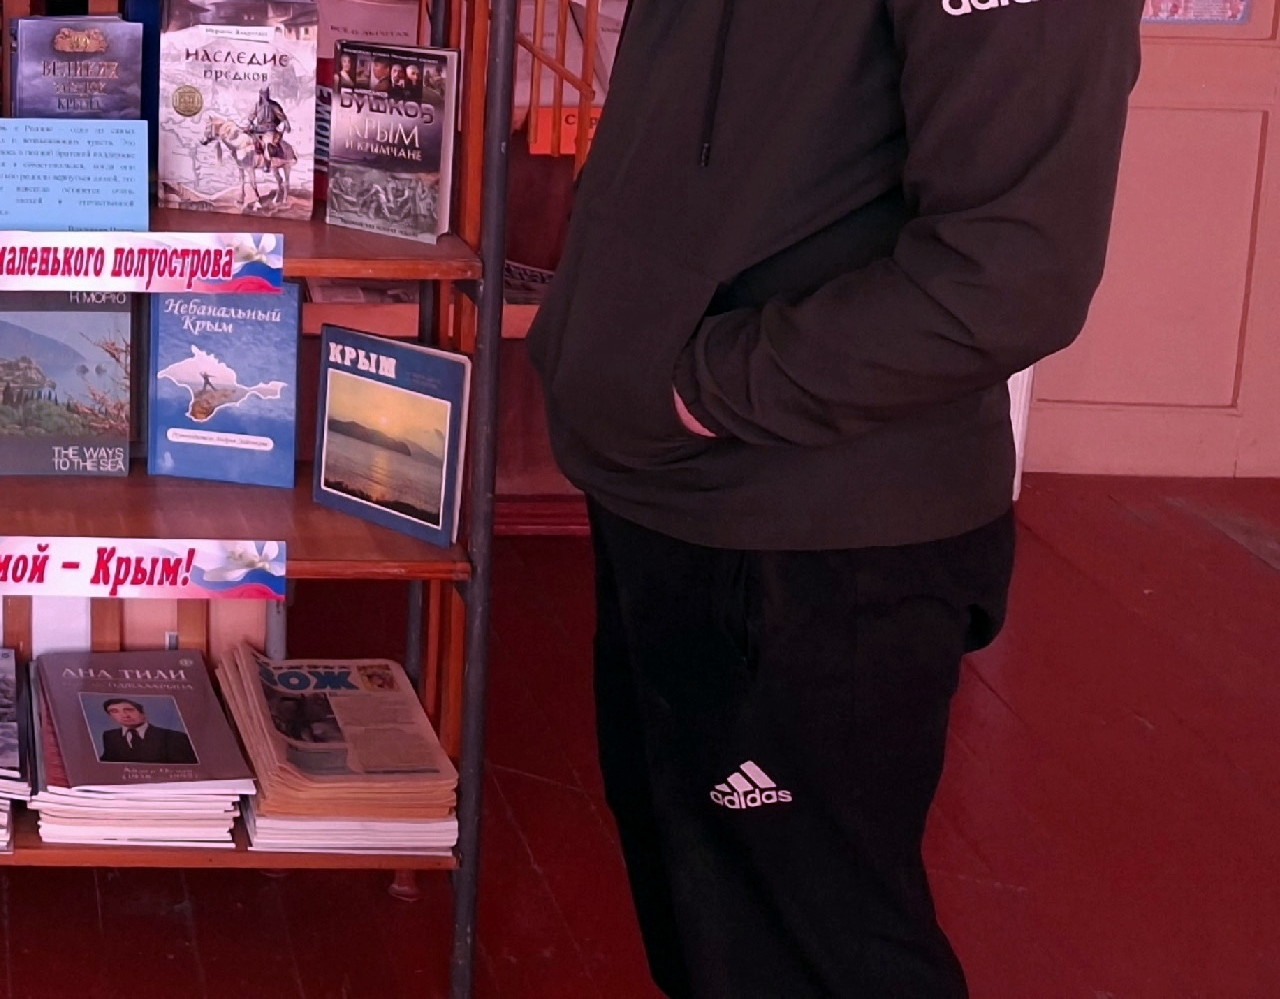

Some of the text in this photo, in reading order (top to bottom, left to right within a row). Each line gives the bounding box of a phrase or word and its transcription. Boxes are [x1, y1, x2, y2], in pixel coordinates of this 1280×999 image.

[185, 48, 290, 69] НАСЛЕДИЕ
[203, 69, 269, 83] ПРЕДКОВ
[340, 87, 435, 124] БУШКОВ
[348, 115, 421, 148] КРЫМ
[355, 141, 422, 162] КРЫМЧАНЕ
[111, 247, 234, 290] полуострова
[164, 299, 282, 323] Небанальный
[183, 317, 234, 335] Крым
[328, 342, 397, 379] КРЫМ
[52, 446, 124, 459] THE WAYS
[52, 458, 125, 472] TO THE SEA
[90, 547, 195, 595] Крым!
[62, 666, 188, 682] АНА ТИЛИ
[709, 788, 793, 809] adidas
